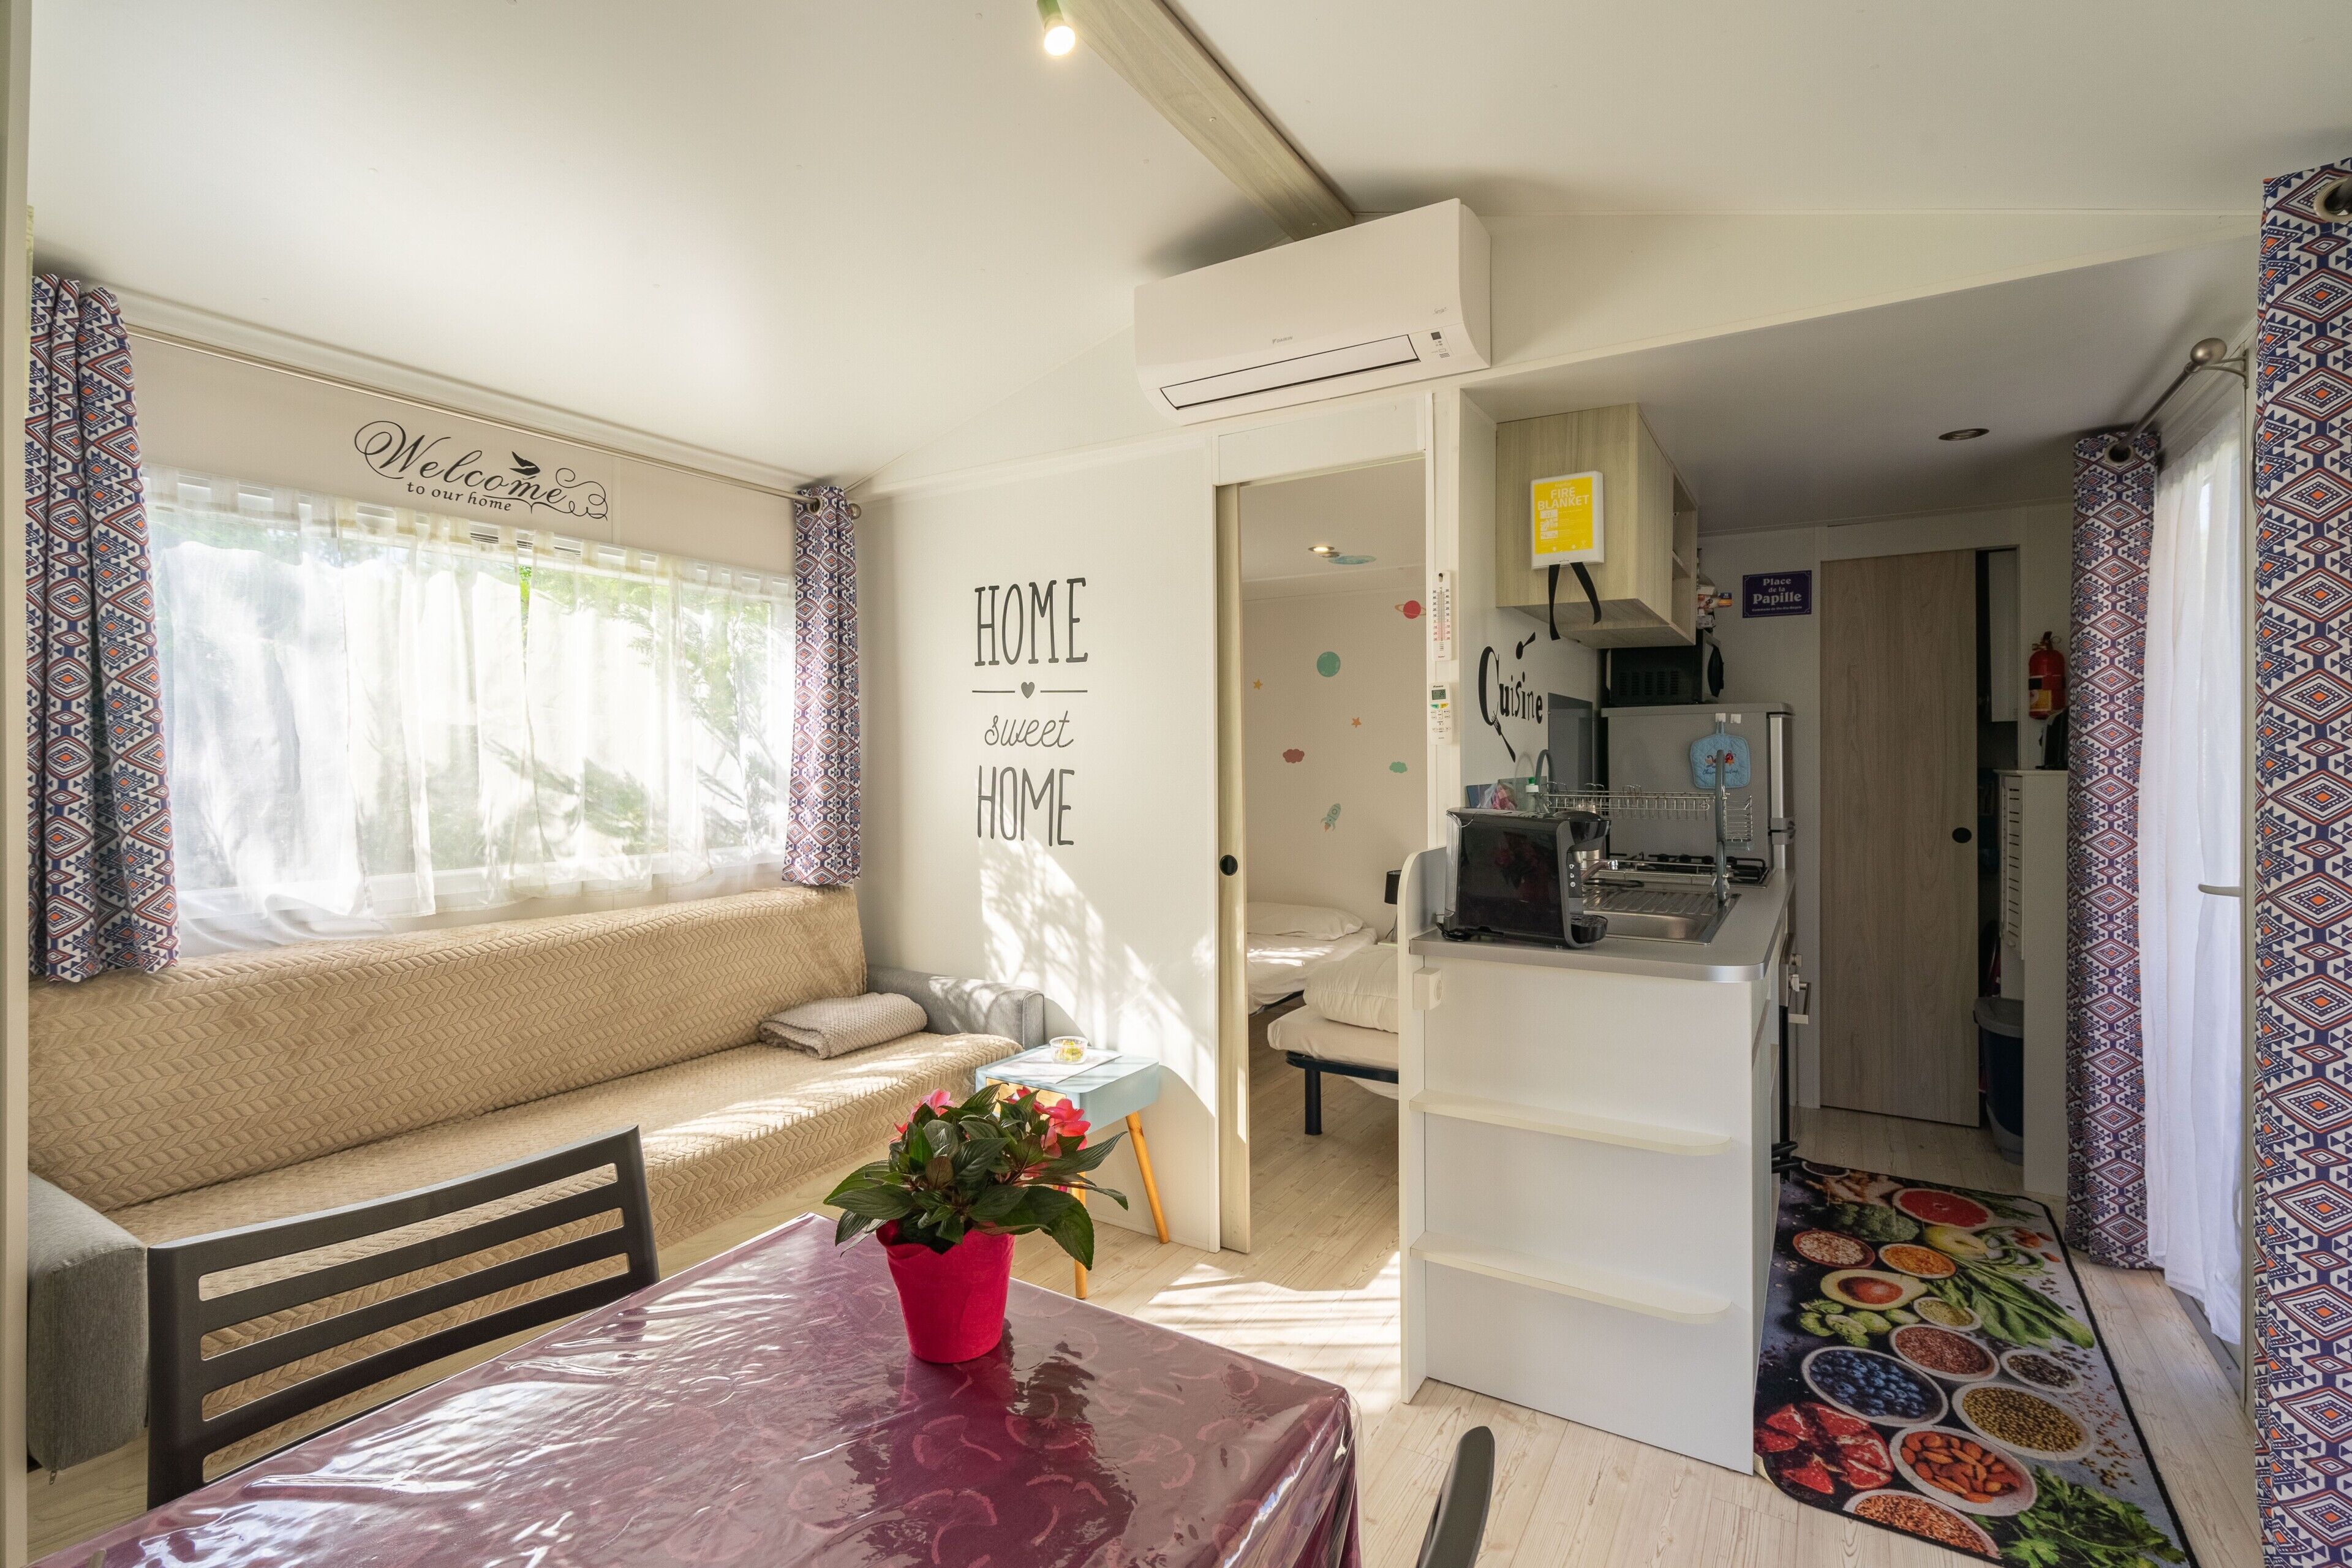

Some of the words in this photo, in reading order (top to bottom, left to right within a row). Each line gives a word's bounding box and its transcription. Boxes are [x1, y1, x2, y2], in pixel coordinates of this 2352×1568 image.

[355, 421, 567, 503] Welcome
[407, 481, 425, 495] to
[431, 489, 464, 502] our
[467, 491, 512, 511] home
[1537, 495, 1590, 511] BLANKET
[1550, 486, 1576, 500] FIRE
[1753, 592, 1802, 605] Papille
[974, 578, 1088, 666] HOME
[1478, 646, 1544, 727] Cuisine
[984, 710, 1074, 748] sweet
[977, 764, 1075, 847] HOME
